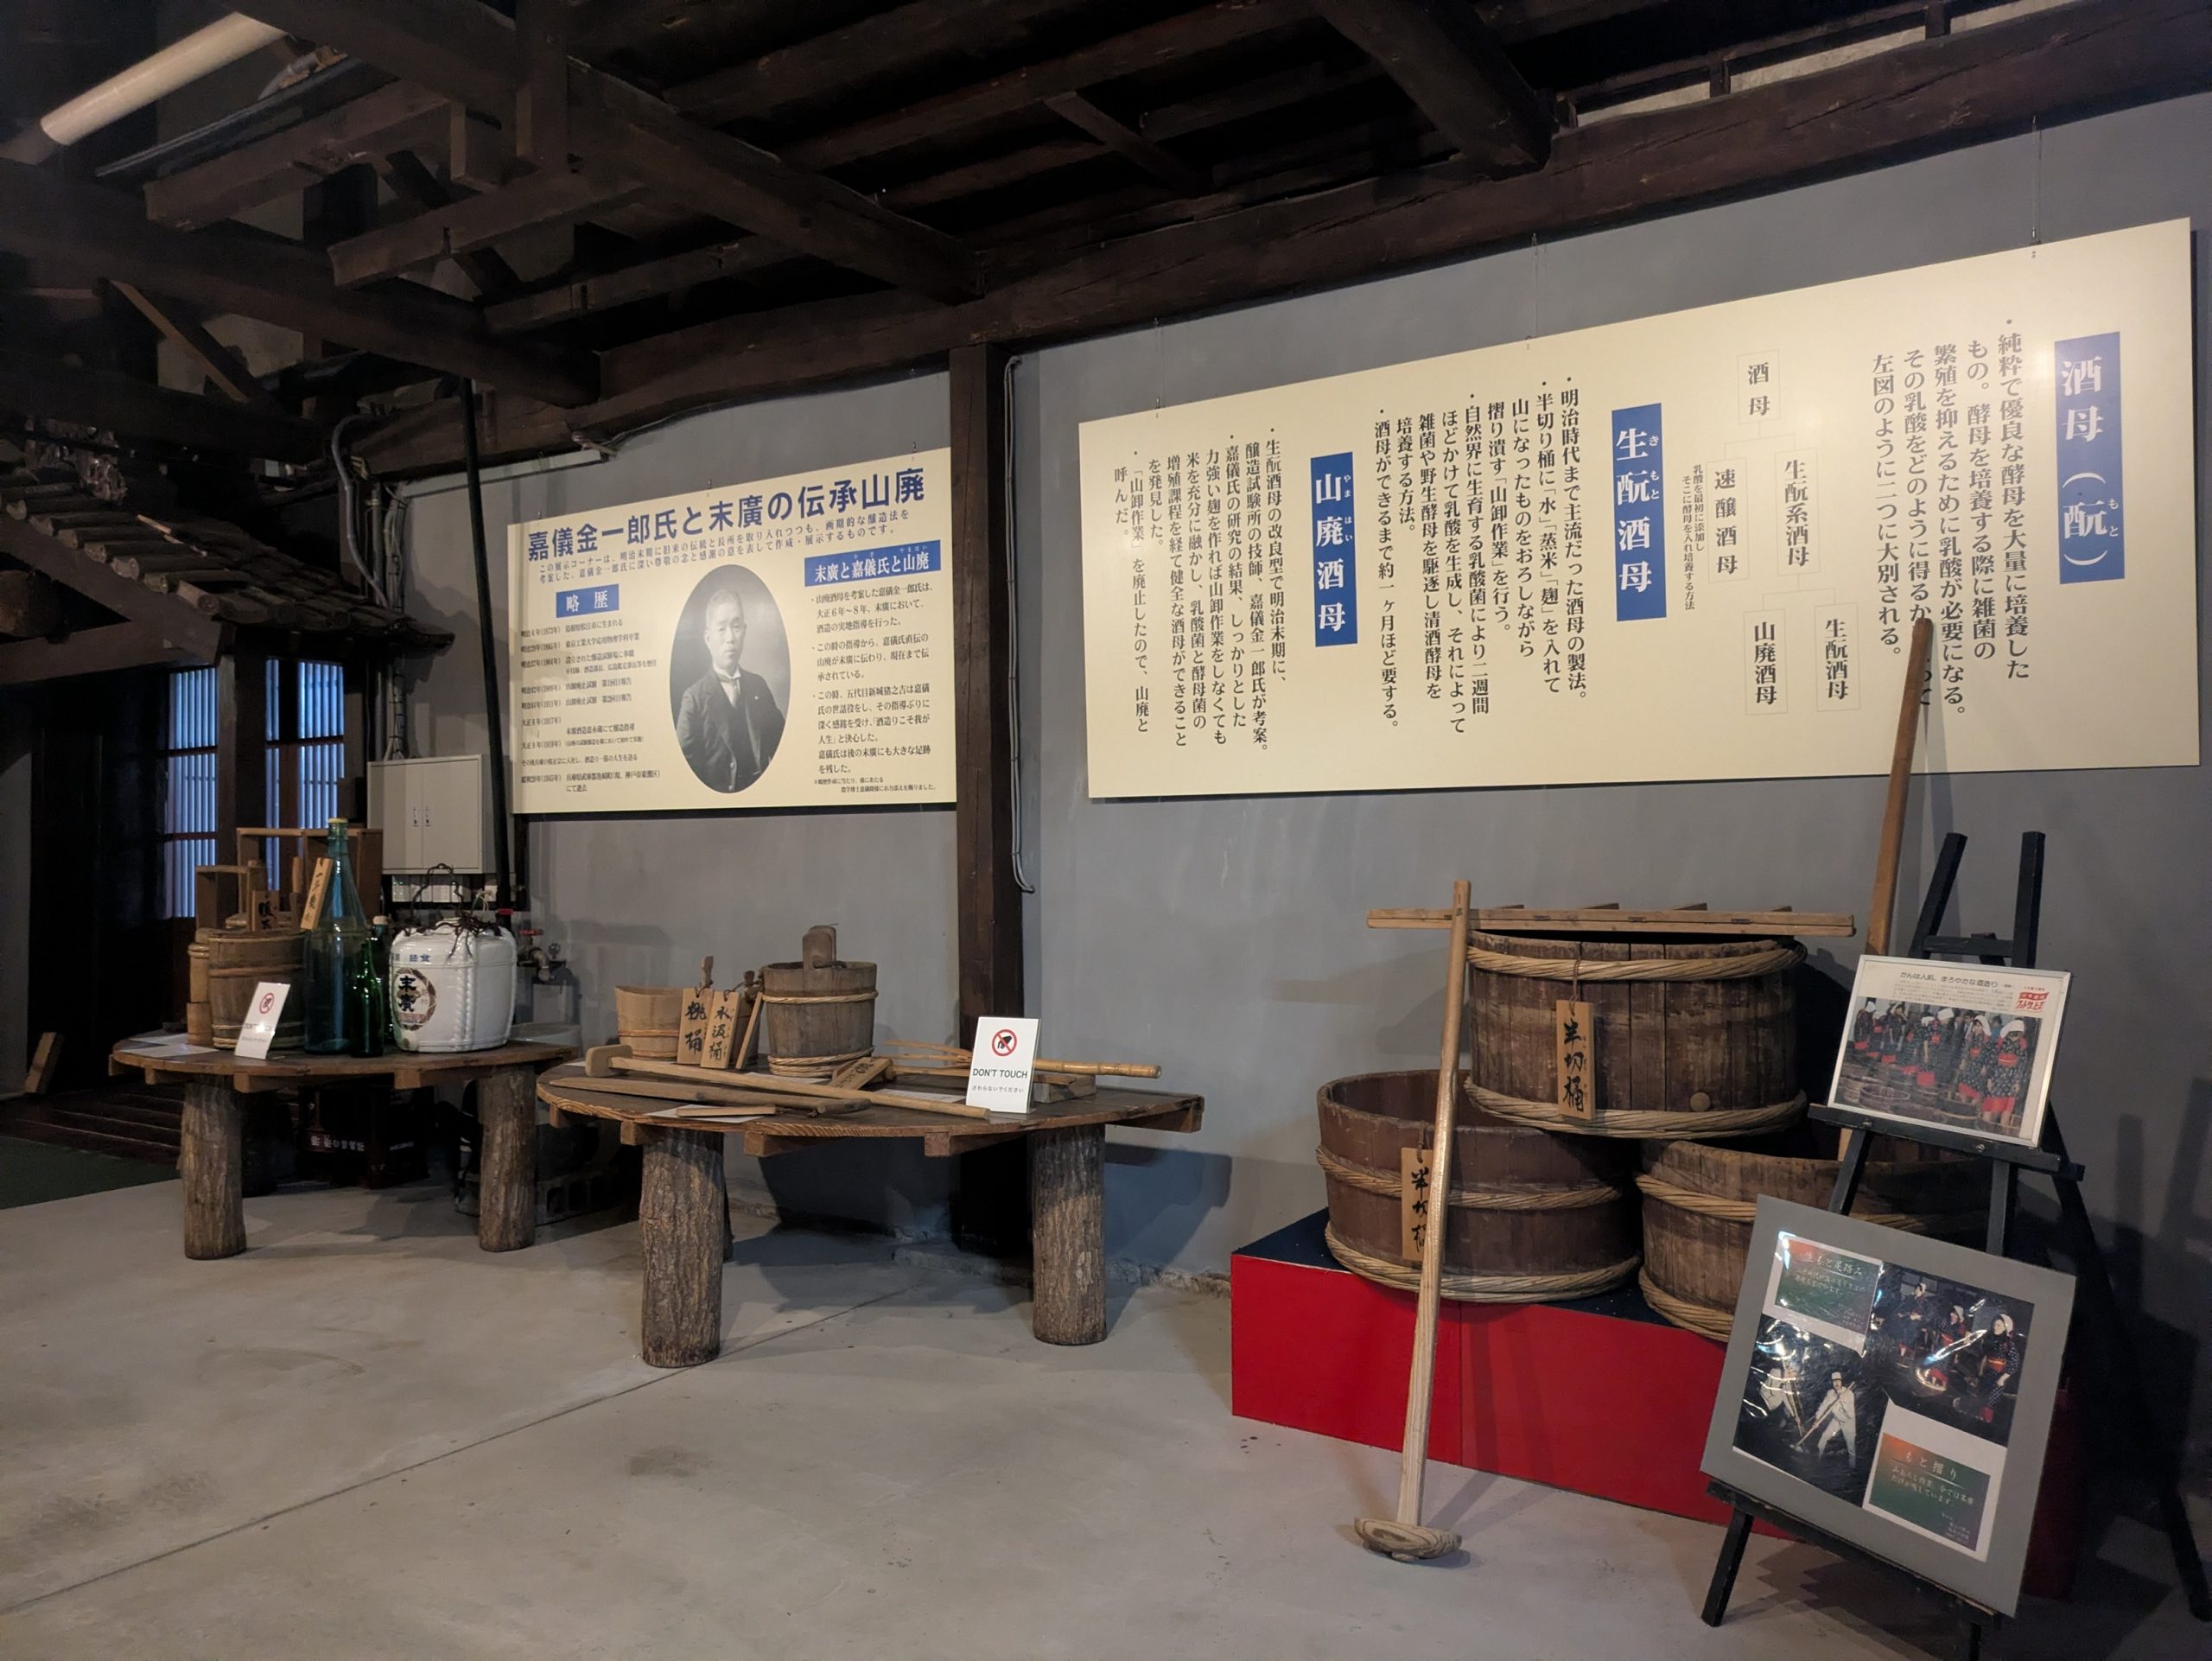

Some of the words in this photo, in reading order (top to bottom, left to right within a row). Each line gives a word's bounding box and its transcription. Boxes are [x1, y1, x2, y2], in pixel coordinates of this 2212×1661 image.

[1747, 361, 1770, 417] 酒母
[528, 468, 925, 562] 嘉儀金一郎氏と末廣の伝承山廃
[1114, 467, 1129, 536] 呼んだ。
[1148, 459, 1164, 546] を発見した。
[1343, 474, 1353, 543] やまはい
[1396, 417, 1415, 531] 培養する方法。
[1488, 402, 1511, 632] 摺り潰す「山卸作業」を行う。
[1616, 428, 1652, 594] 生酛酒母
[1693, 464, 1706, 551] 乳酸を最初に添加し
[1714, 468, 1738, 575] 速醸酒母
[1783, 459, 1810, 568] 生酛系酒母
[1872, 354, 1901, 656] 左図のように二つに大別される。
[1967, 340, 1996, 660] もの。酵母を培養する際に雑菌の
[2109, 498, 2120, 538] もと
[814, 551, 930, 583] 末廣と嘉儀氏と山廃
[1315, 473, 1346, 633] 山廃酒母
[1418, 413, 1442, 700] 雑菌や野生酵母を駆逐し清酒酵母を
[1442, 410, 1465, 734] ほどかけて乳酸を生成し、それによって
[1512, 398, 1535, 658] 山になったものをおろしながら
[1681, 475, 1695, 611] そこに酵母を入れ培養する方法
[1933, 343, 1965, 715] 繁殖を抑えるために乳酸が必要になる。
[566, 589, 609, 613] 略歴
[1186, 452, 1207, 729] 米を充分に融かし、乳酸菌と酵母菌の
[1205, 449, 1227, 745] 力強い麹を作れば山卸作業をしなくても
[1244, 442, 1268, 750] 醸造試験所の技師、嘉儀金一郎氏が考案。
[817, 671, 865, 682] 承されている。
[1754, 621, 1777, 706] 山廃酒母
[1824, 618, 1849, 701] 生酛酒母
[818, 764, 851, 774] を残した。
[972, 1068, 998, 1078] DON'T
[999, 1069, 1028, 1079] TOUCH
[972, 1085, 1024, 1093] さわらないでください
